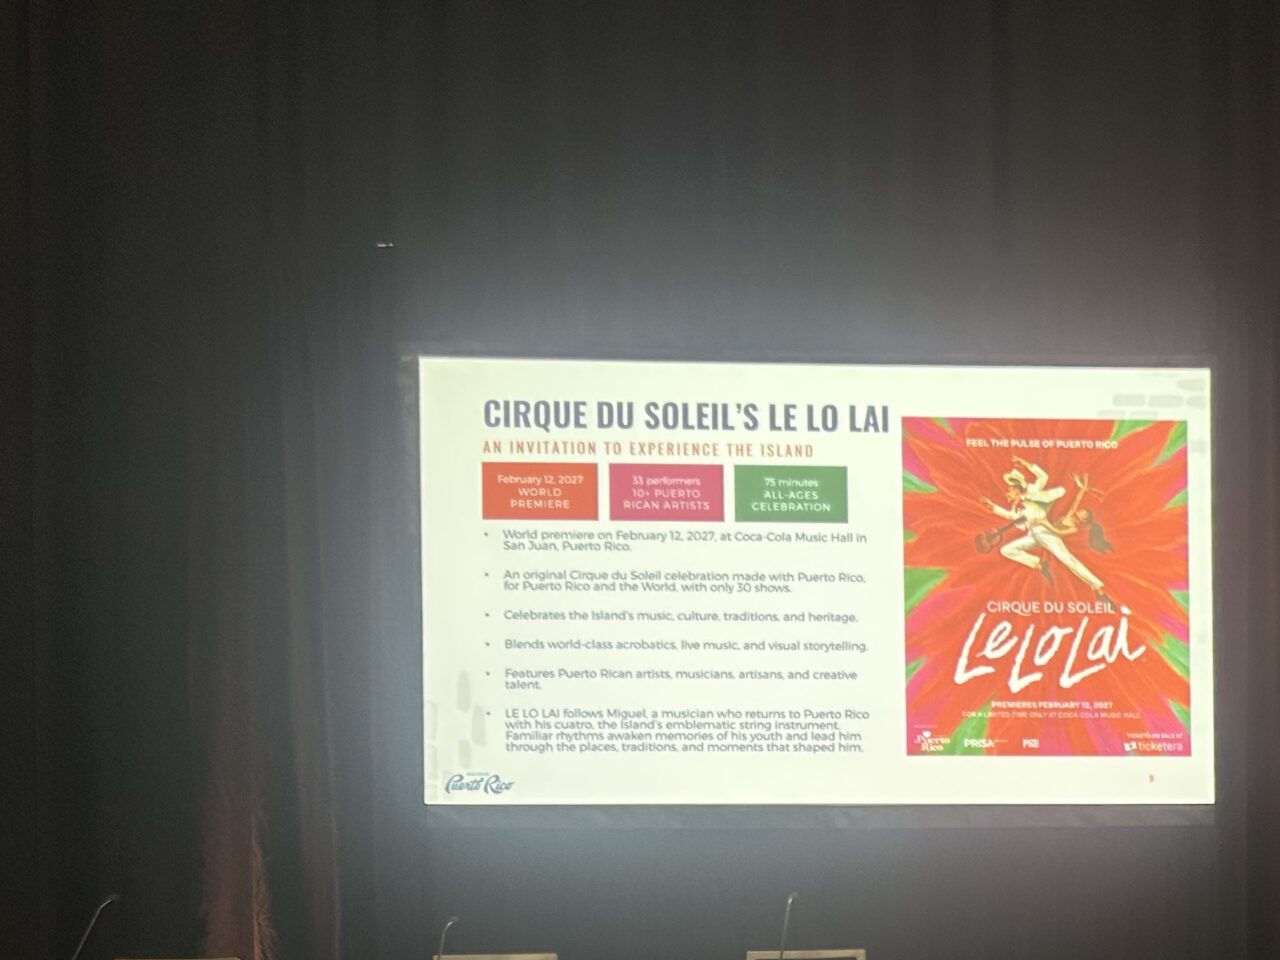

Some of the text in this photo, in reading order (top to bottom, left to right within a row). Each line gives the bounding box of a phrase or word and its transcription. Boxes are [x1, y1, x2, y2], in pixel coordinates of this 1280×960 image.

[484, 400, 889, 433] CIRQUE DU SOLEIL'S LE LO LAI
[483, 441, 813, 457] AN INVITATION TO EXPERIENCE THE ISLAND
[966, 439, 989, 447] FEEL
[991, 439, 1009, 447] THE
[1011, 440, 1040, 448] PULSE
[1042, 440, 1054, 448] OF
[1056, 440, 1093, 448] PUERTO
[497, 475, 584, 485] February 12, 2027
[632, 476, 701, 487] 33 performers
[763, 477, 818, 487] 75 minutes
[518, 488, 562, 496] WORLD
[632, 489, 700, 498] 10+ PUERTO
[764, 491, 818, 499] ALL-AGES
[510, 499, 570, 508] PREMIERE
[623, 501, 710, 510] RICAN ARTISTS
[752, 502, 831, 511] CELEBRATION
[503, 530, 537, 539] World
[542, 531, 594, 542] premiere
[598, 532, 612, 540] on
[616, 531, 666, 542] February
[670, 531, 683, 541] 12,
[720, 532, 732, 541] at
[735, 532, 791, 542] Coca-Cola
[796, 533, 828, 542] Music
[832, 533, 853, 542] Hall
[857, 533, 867, 542] in
[503, 541, 632, 552] San Juan, Puerto Rico.
[504, 570, 866, 583] An original Cirque du Soleil celebration made with Puerto Rico,
[504, 581, 519, 591] for
[523, 582, 561, 591] Puerto
[566, 582, 590, 591] Rico
[594, 582, 616, 591] and
[619, 582, 638, 591] the
[681, 583, 706, 592] with
[710, 583, 734, 594] only
[737, 583, 751, 592] 30
[754, 583, 791, 593] shows.
[987, 600, 1115, 616] CIRQUE DU SOLEIL
[504, 610, 858, 624] Celebrates the Island's music, culture, traditions, and heritage.
[505, 639, 868, 653] Blends world-class acrobatics, live music, and visual storytelling.
[505, 669, 857, 680] Features Puerto Rican artists, musicians, artisans, and creative
[505, 680, 542, 689] talent.
[991, 701, 1038, 709] PREMIERES
[1039, 701, 1080, 709] FEBRUARY
[506, 709, 519, 718] LE
[523, 709, 538, 718] LO
[542, 709, 559, 718] LAI
[563, 709, 603, 719] follows
[607, 709, 648, 721] Miguel,
[662, 710, 713, 719] musician
[717, 710, 742, 719] who
[746, 710, 785, 719] returns
[789, 711, 800, 719] to
[804, 710, 841, 719] Puerto
[845, 710, 869, 719] Rico
[506, 720, 840, 731] with his cuatro, the Island's emblematic string instrument.
[506, 731, 861, 742] Familiar rhythms awaken memories of his youth and lead him
[506, 742, 863, 754] through the places, traditions, and moments that shaped him.
[445, 774, 515, 794] Puerto Rico
